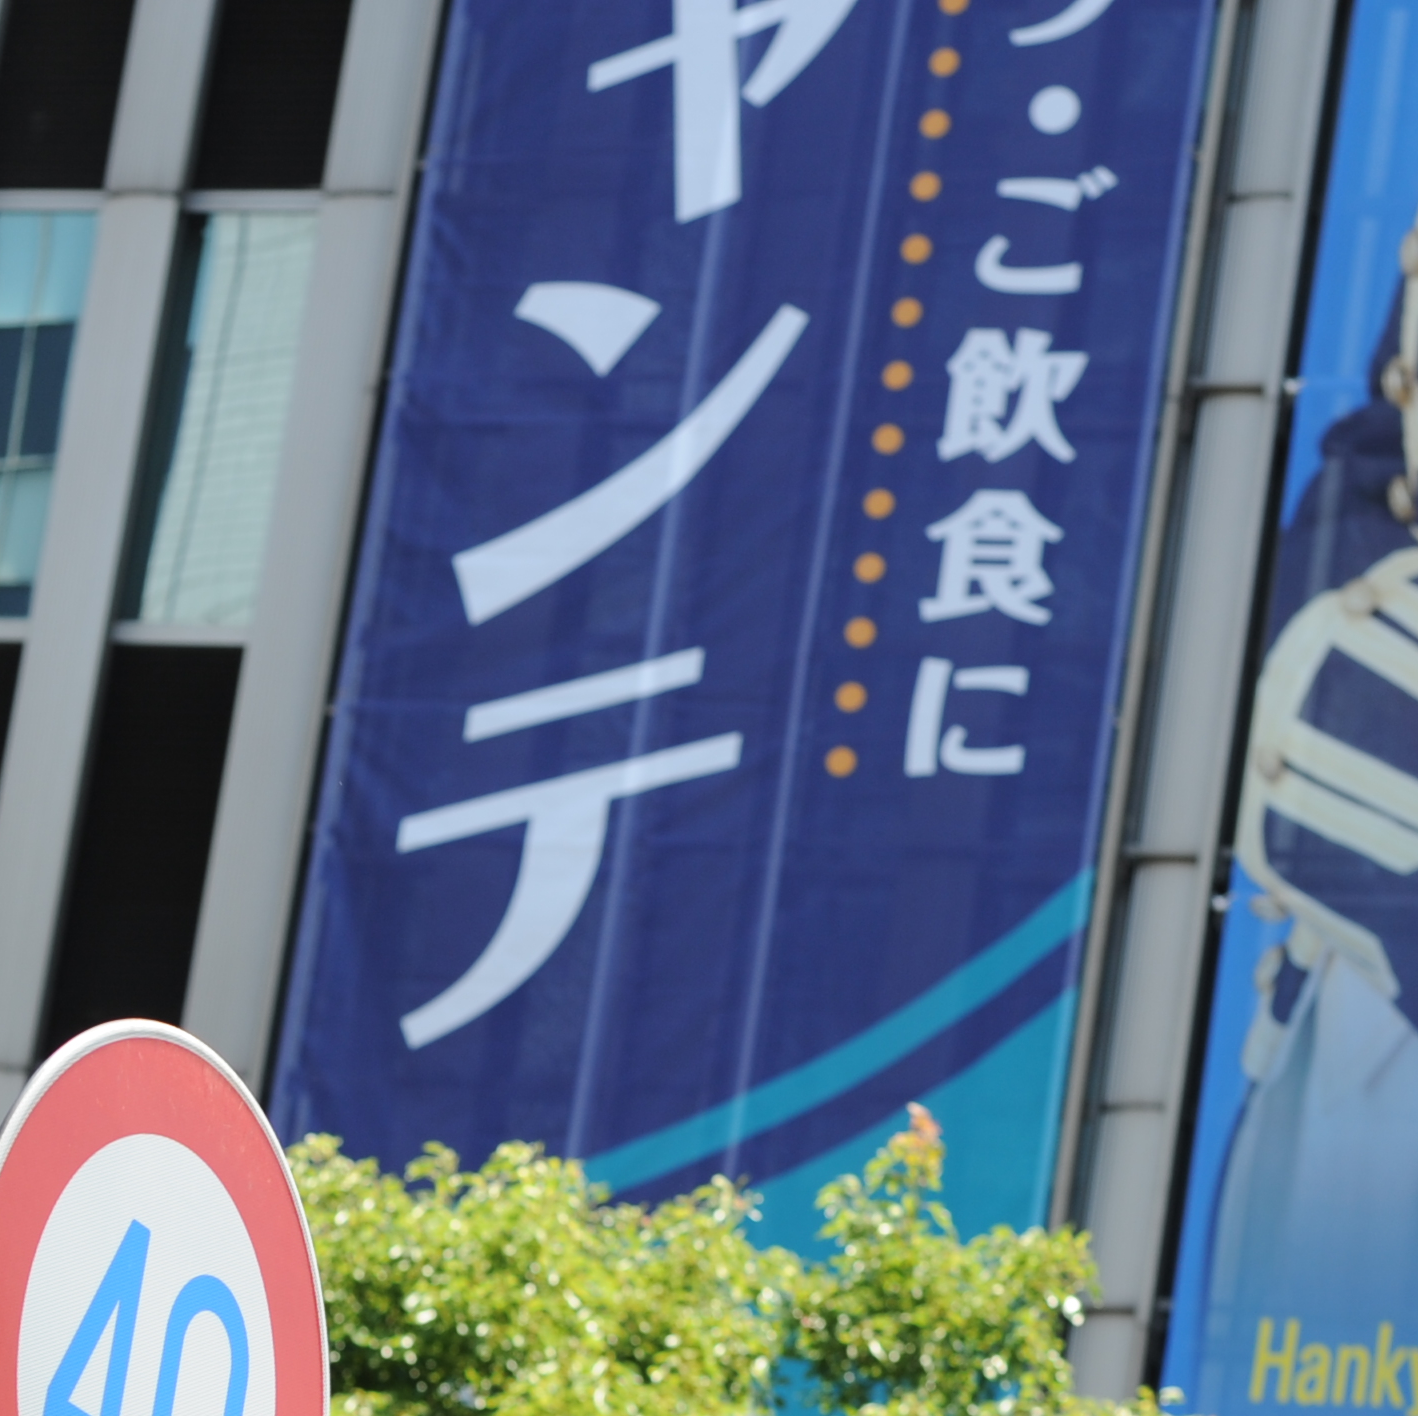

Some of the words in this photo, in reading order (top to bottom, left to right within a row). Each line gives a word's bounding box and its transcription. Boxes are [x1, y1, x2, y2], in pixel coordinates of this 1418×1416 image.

[903, 0, 1119, 778] ・ご飲食に
